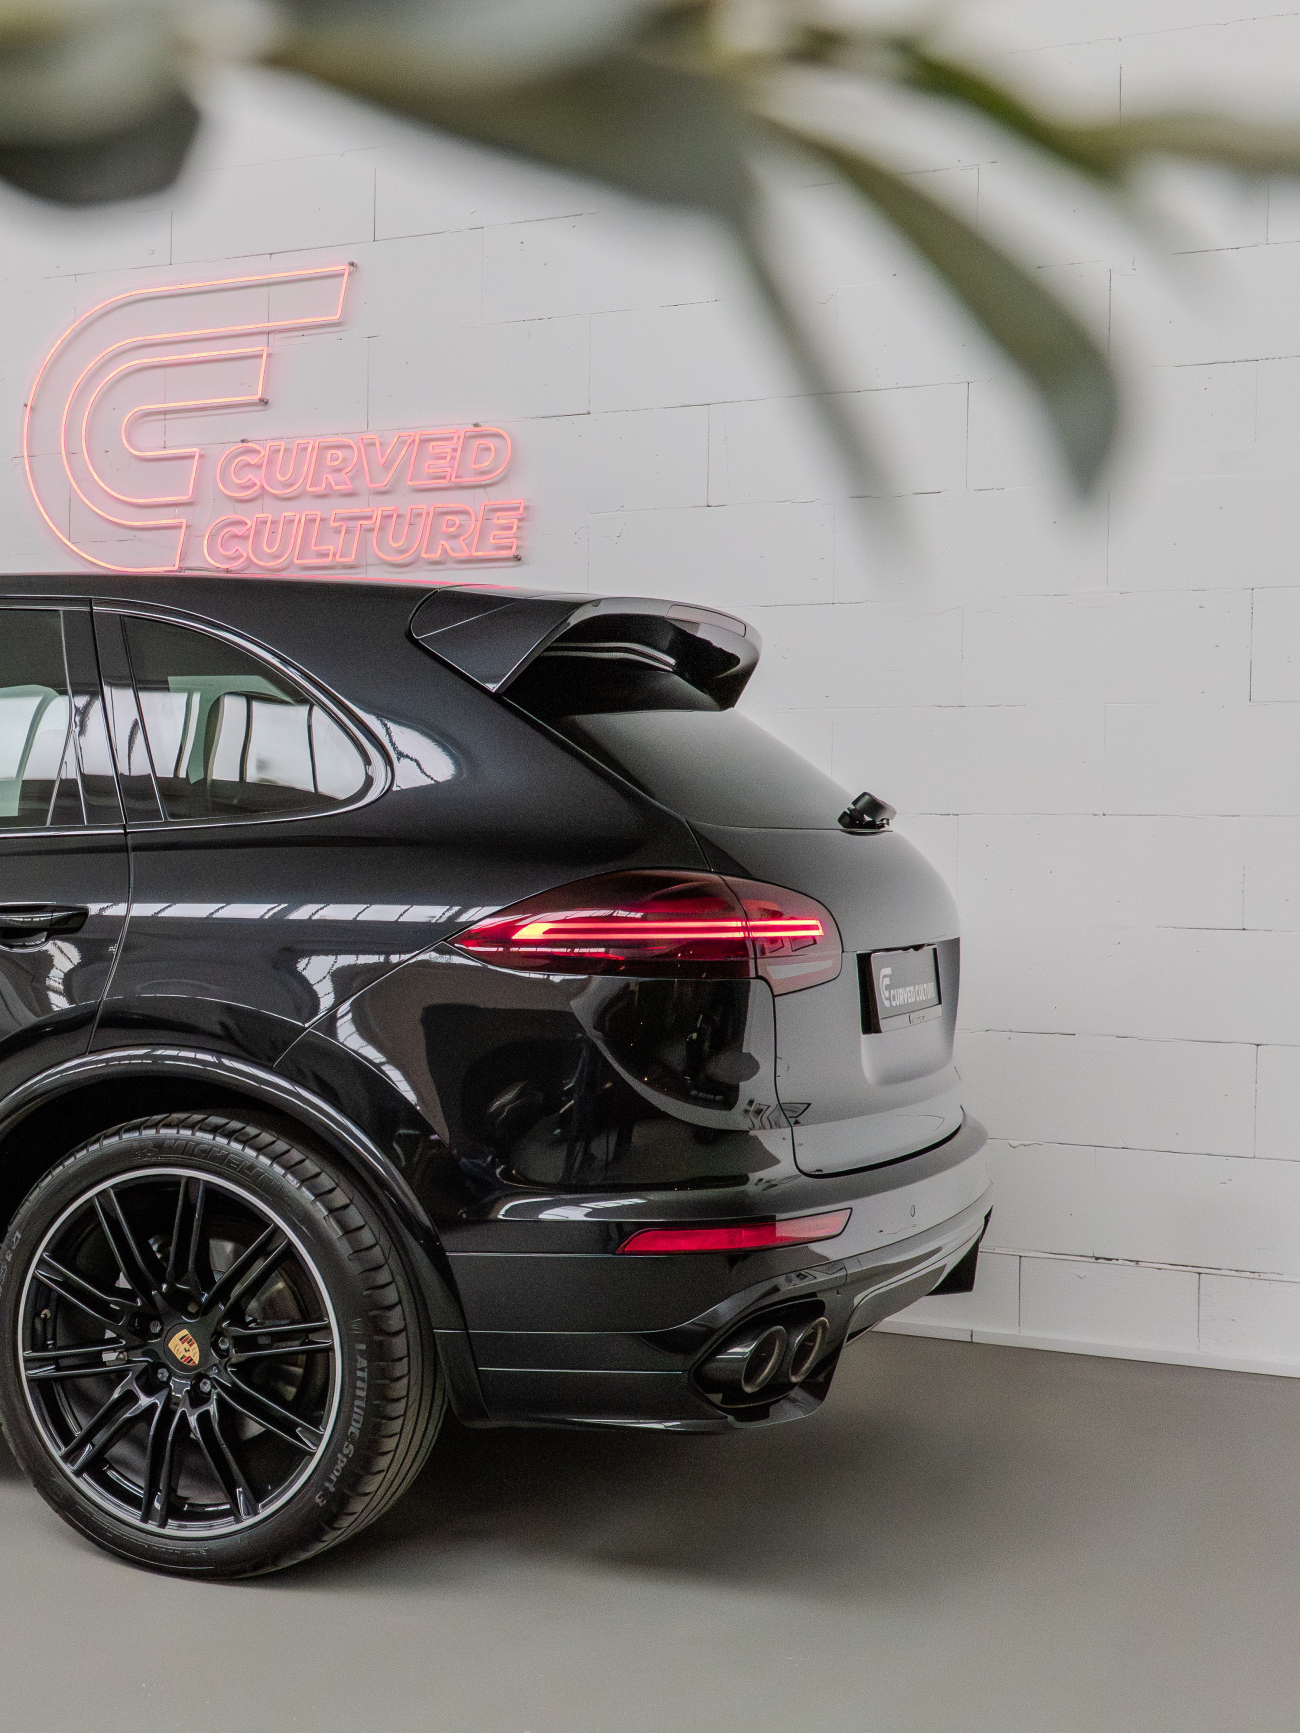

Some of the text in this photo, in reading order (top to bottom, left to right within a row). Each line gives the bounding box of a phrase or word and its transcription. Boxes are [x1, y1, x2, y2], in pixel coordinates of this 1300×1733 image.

[216, 427, 512, 498] CURVED
[203, 499, 525, 568] CULTURE
[890, 985, 916, 1007] CURVED
[324, 1440, 355, 1492] Sport
[315, 1491, 327, 1507] 3
